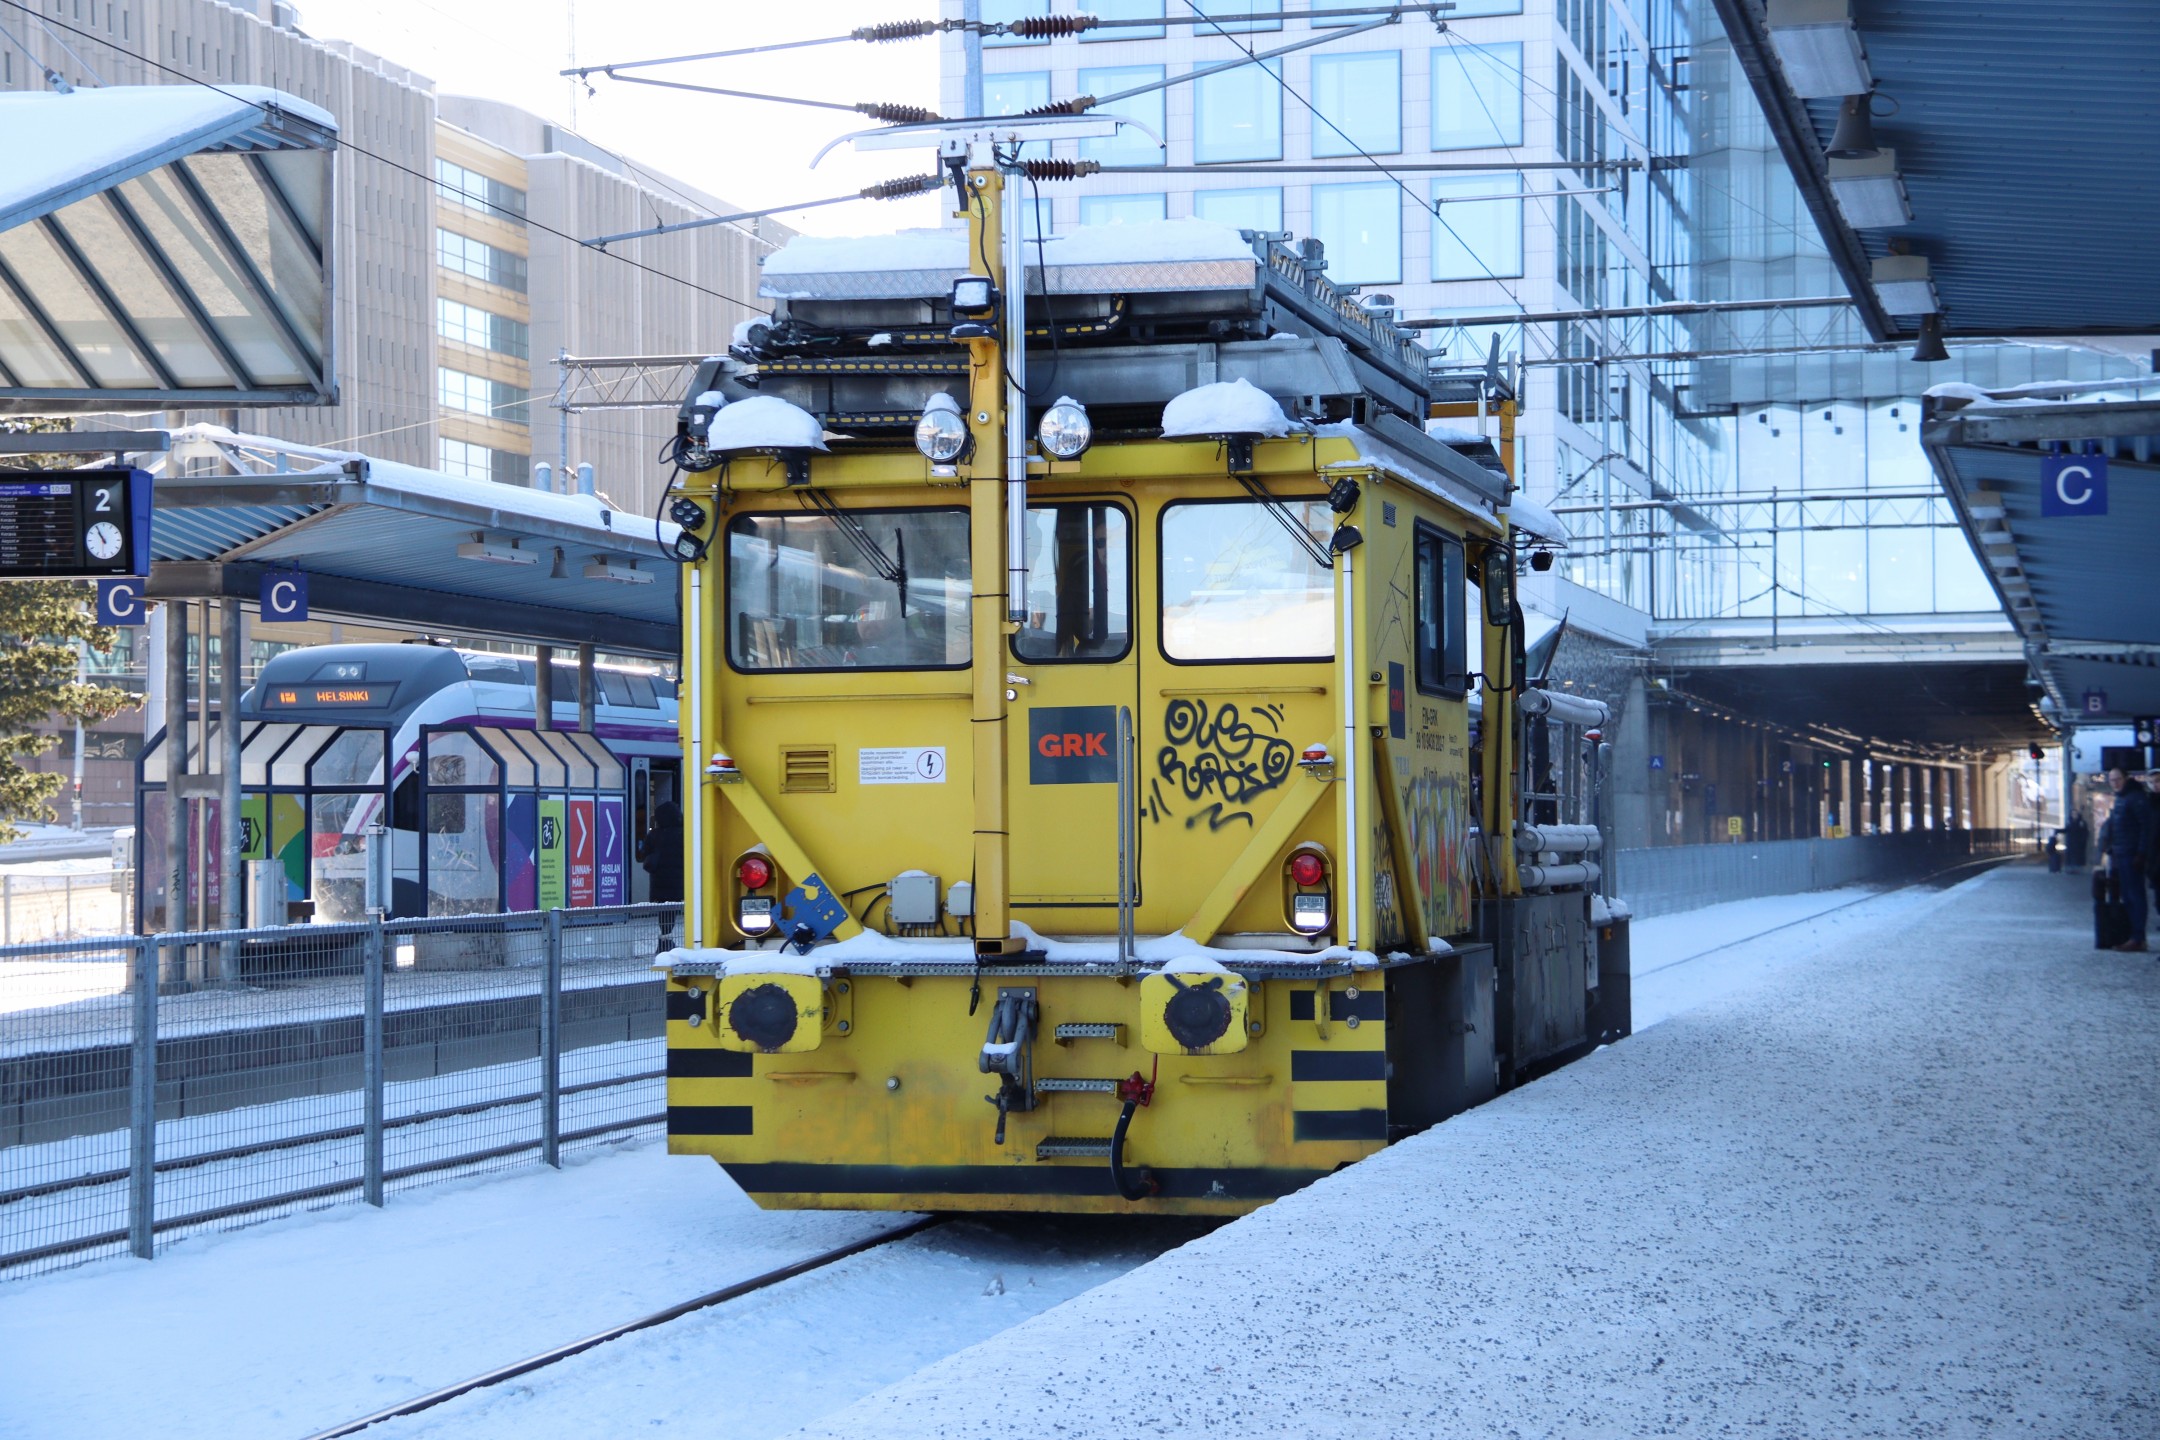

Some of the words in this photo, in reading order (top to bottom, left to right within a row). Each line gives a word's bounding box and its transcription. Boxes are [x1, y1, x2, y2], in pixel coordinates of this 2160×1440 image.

[2056, 465, 2093, 506] C
[95, 488, 111, 512] 2
[107, 584, 135, 617] C
[270, 580, 298, 613] C
[316, 690, 369, 702] HELSINKI
[2088, 696, 2103, 712] B
[1037, 732, 1109, 758] GRK
[1652, 757, 1663, 768] A
[1782, 761, 1791, 772] 2
[1730, 818, 1739, 830] B
[571, 864, 592, 876] LINNAN-
[601, 863, 621, 874] PASILAN
[571, 875, 585, 888] MÄKI
[601, 876, 618, 886] ASEMA
